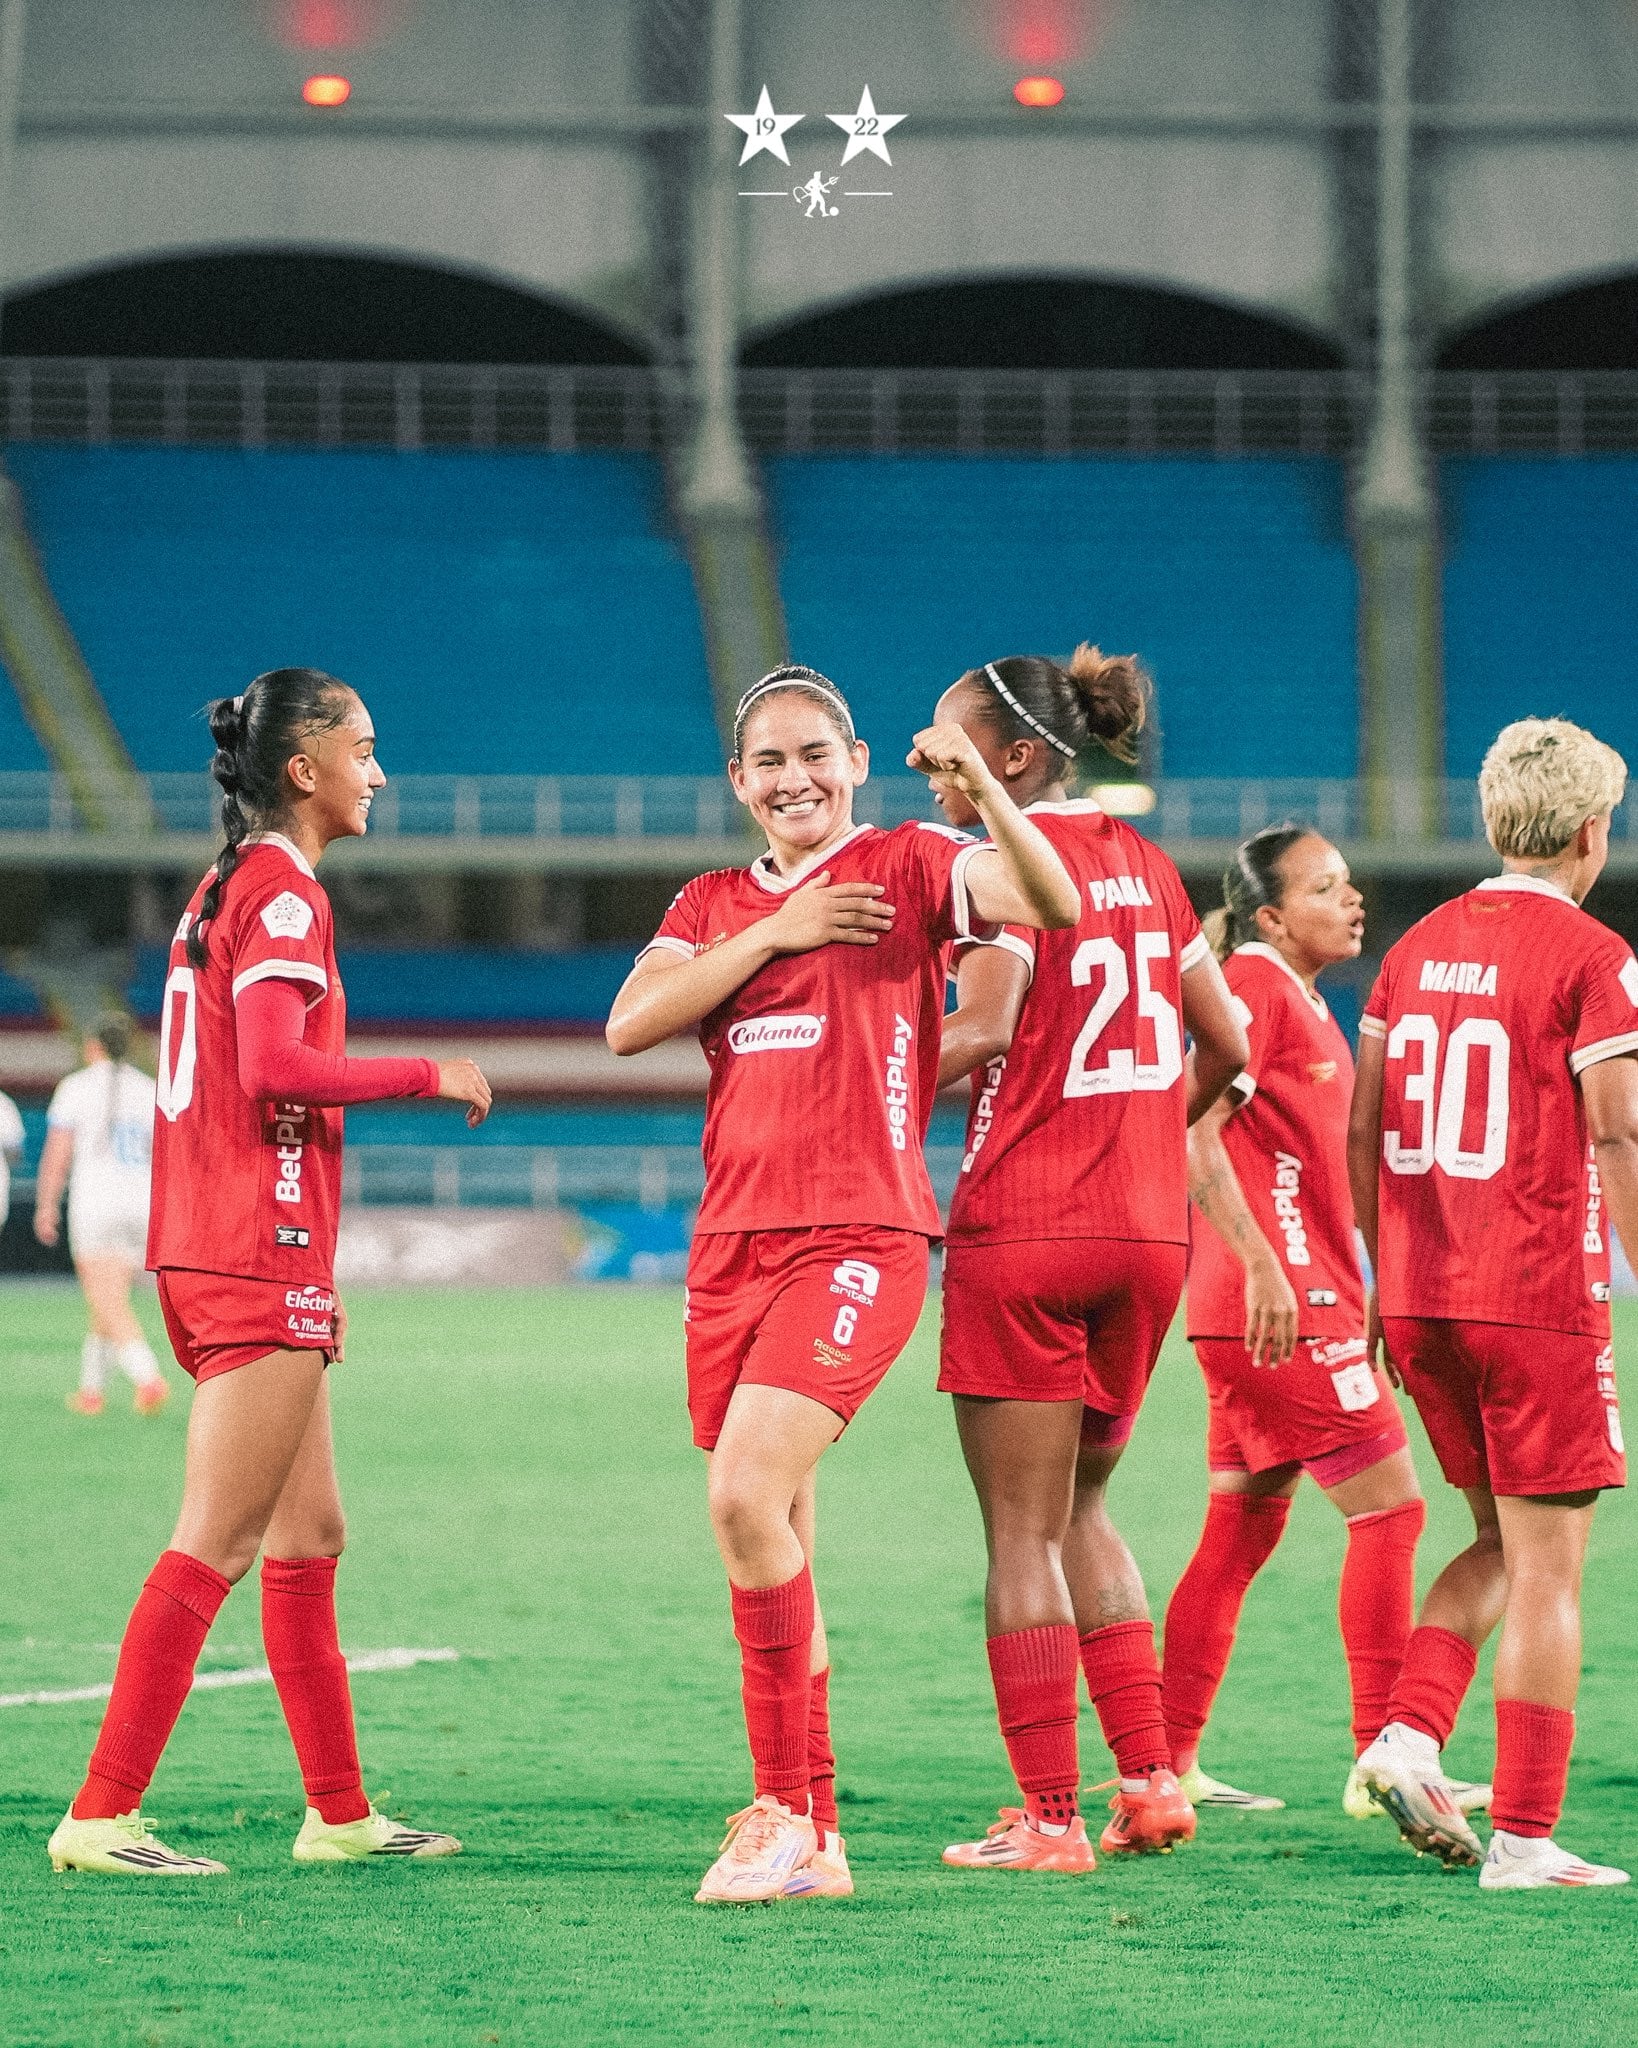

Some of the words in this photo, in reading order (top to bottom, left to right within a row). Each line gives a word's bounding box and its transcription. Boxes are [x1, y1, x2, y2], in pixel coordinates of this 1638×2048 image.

[1419, 960, 1498, 997] MAIRA
[1063, 931, 1183, 1099] 25
[732, 1026, 817, 1047] Colanta
[1384, 1014, 1511, 1180] 30
[829, 1284, 874, 1308] aritex
[833, 1305, 858, 1346] 6
[813, 1338, 852, 1362] Reebok
[727, 1872, 783, 1886] F50
